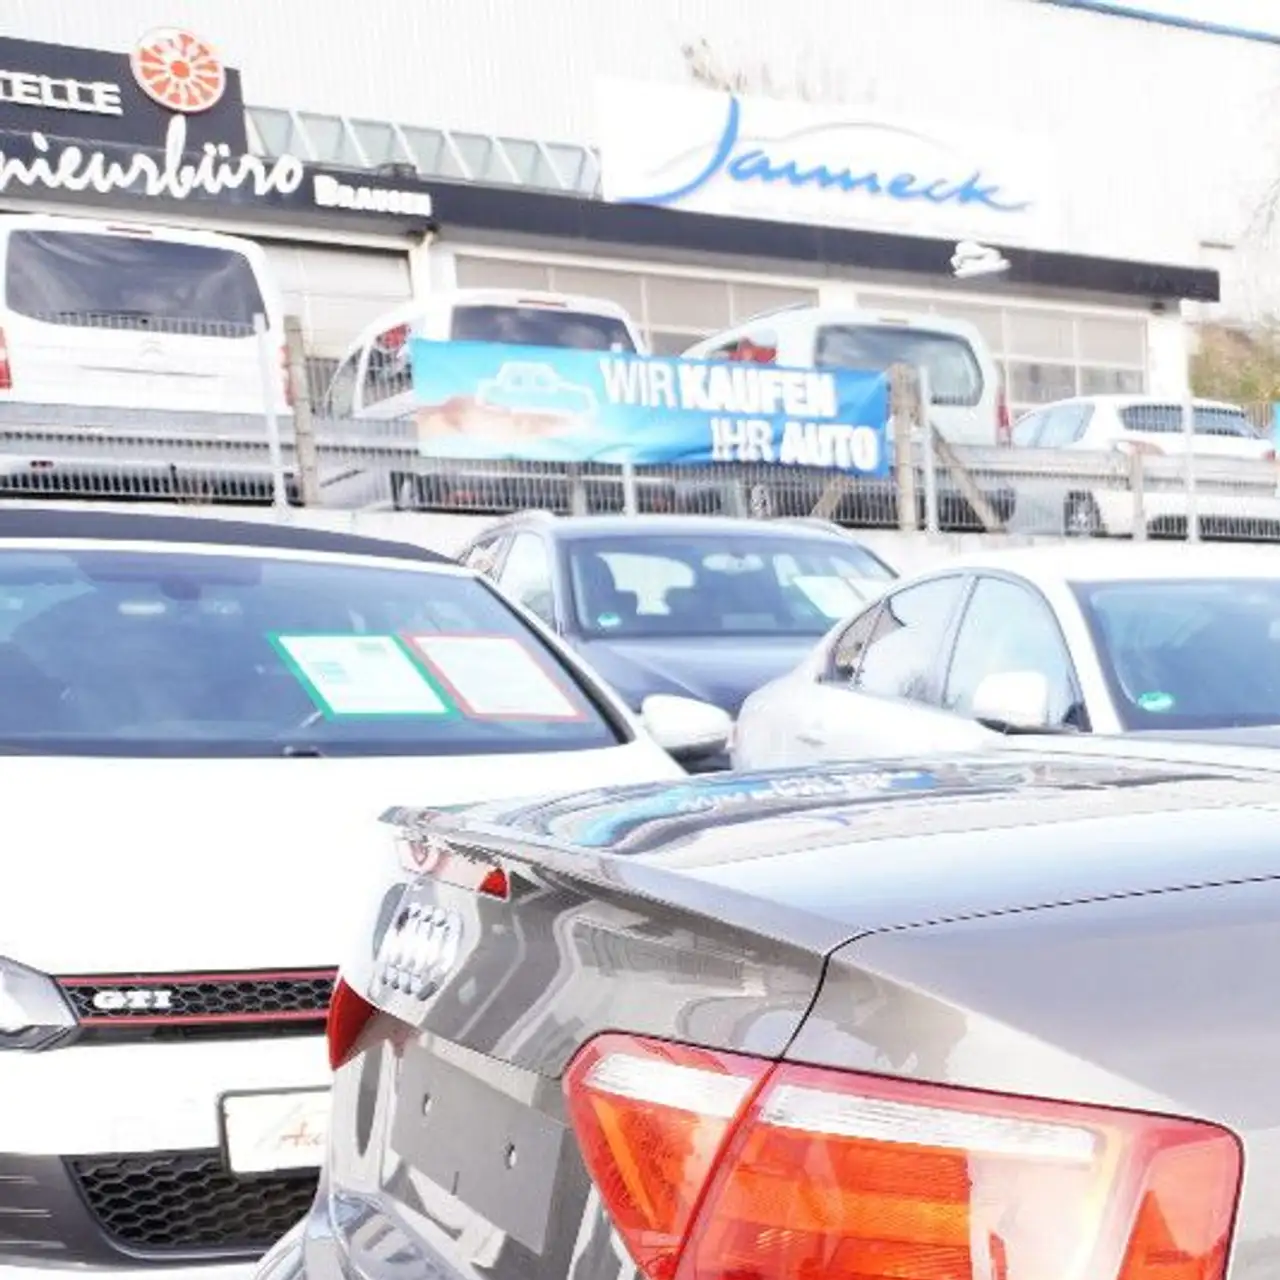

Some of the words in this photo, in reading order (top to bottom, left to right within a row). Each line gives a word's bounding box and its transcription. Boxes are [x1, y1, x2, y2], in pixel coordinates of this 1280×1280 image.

[602, 359, 675, 406] WIR
[682, 364, 834, 417] KAUFEN
[712, 418, 773, 461] IHR
[782, 423, 878, 470] AUTO
[93, 989, 173, 1010] GTI
